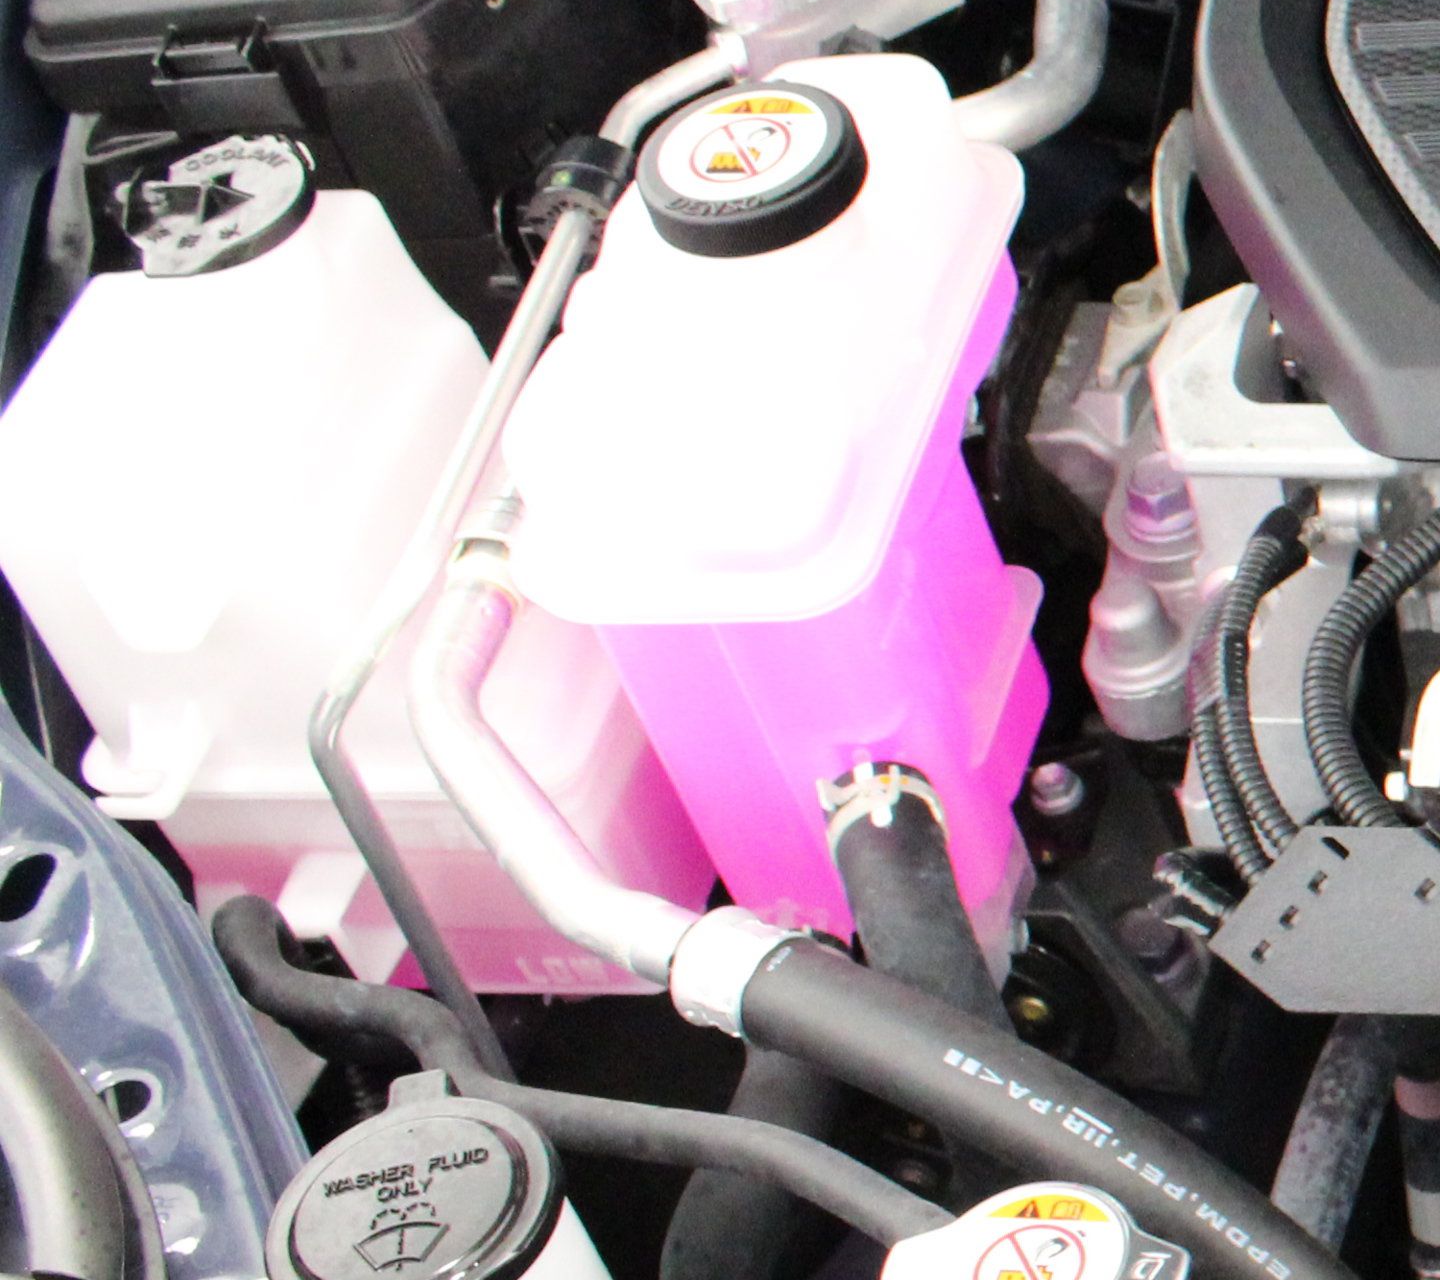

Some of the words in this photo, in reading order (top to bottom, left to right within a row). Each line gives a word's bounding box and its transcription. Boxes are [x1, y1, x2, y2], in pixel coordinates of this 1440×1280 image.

[323, 1163, 415, 1198] WASHER
[428, 1147, 489, 1173] FLUID
[377, 1176, 433, 1203] ONLY
